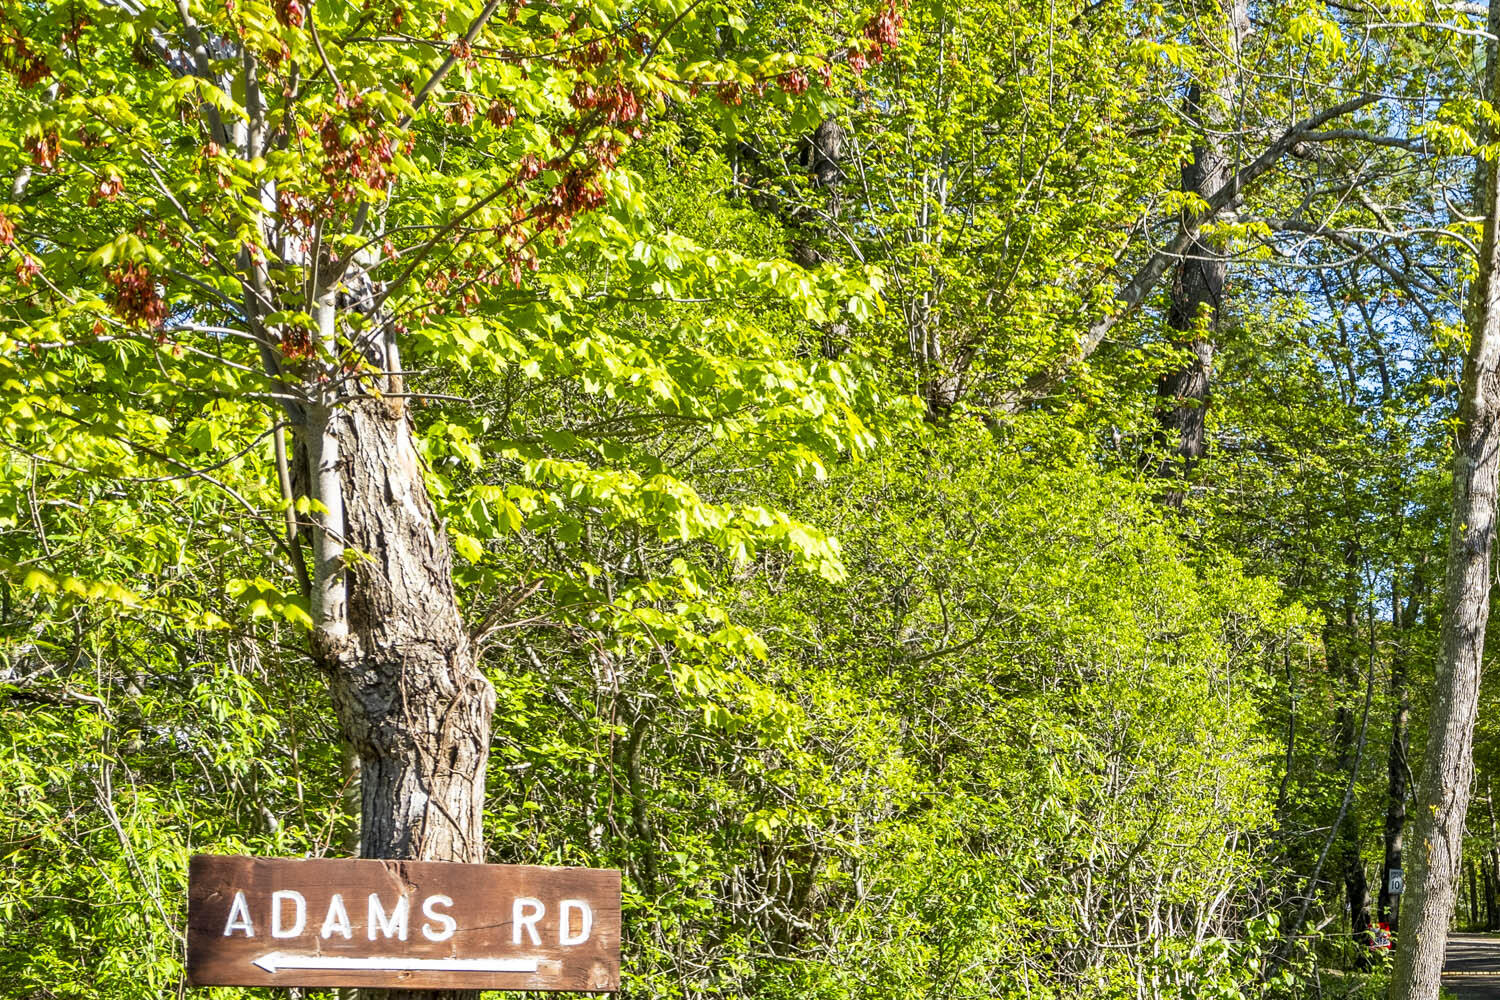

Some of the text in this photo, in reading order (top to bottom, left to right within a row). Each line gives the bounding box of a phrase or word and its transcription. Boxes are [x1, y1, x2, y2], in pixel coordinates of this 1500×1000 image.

[1391, 880, 1400, 890] 10
[223, 889, 594, 947] ADAMS RD
